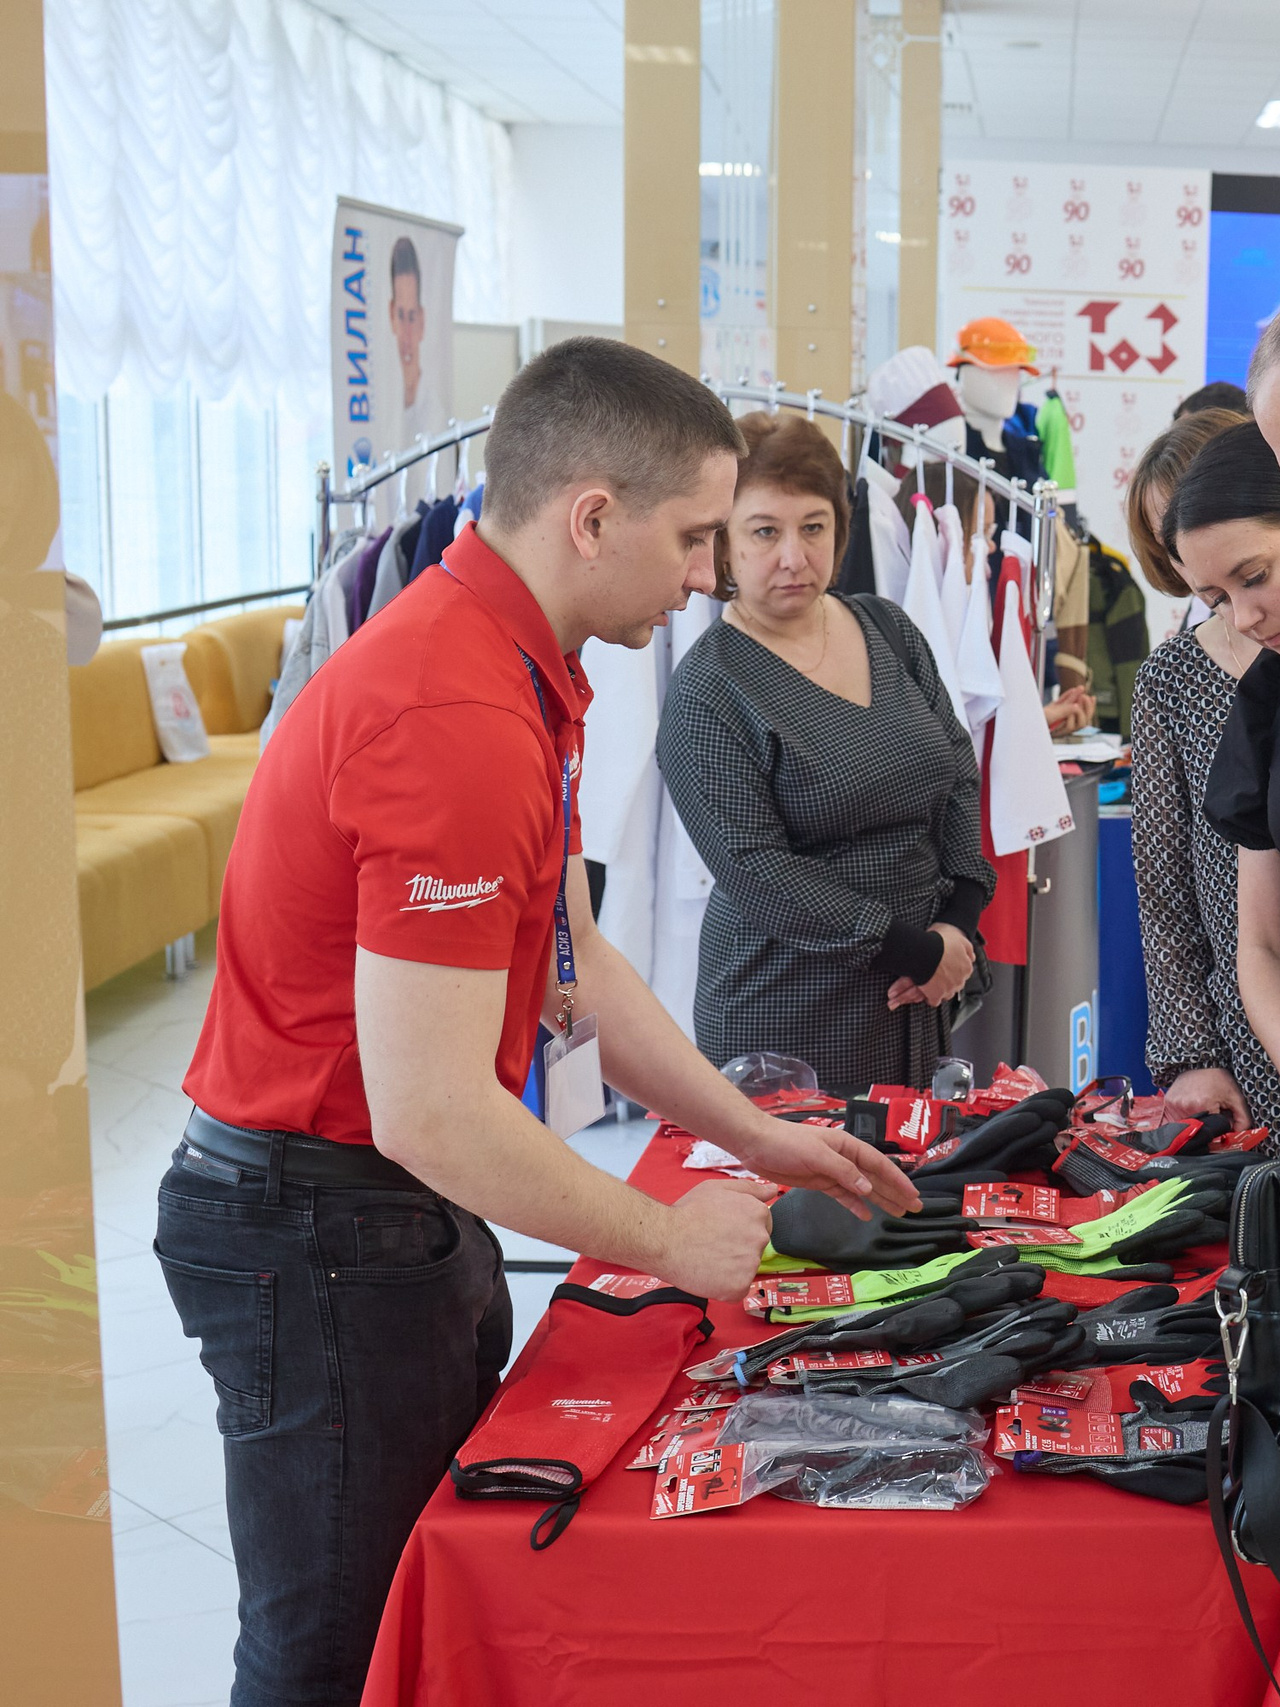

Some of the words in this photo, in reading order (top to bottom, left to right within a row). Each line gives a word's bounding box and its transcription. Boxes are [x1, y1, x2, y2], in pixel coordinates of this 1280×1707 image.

[949, 196, 976, 217] 90
[1063, 201, 1090, 222] 90
[1177, 206, 1202, 227] 90
[1005, 253, 1034, 274] 90
[1118, 258, 1145, 279] 90
[342, 226, 370, 423] ВИЛАН
[403, 874, 501, 907] Milwaukee
[558, 929, 571, 957] АСИЗ
[898, 1098, 925, 1141] Milwaukee
[550, 1398, 613, 1407] Milwaukee
